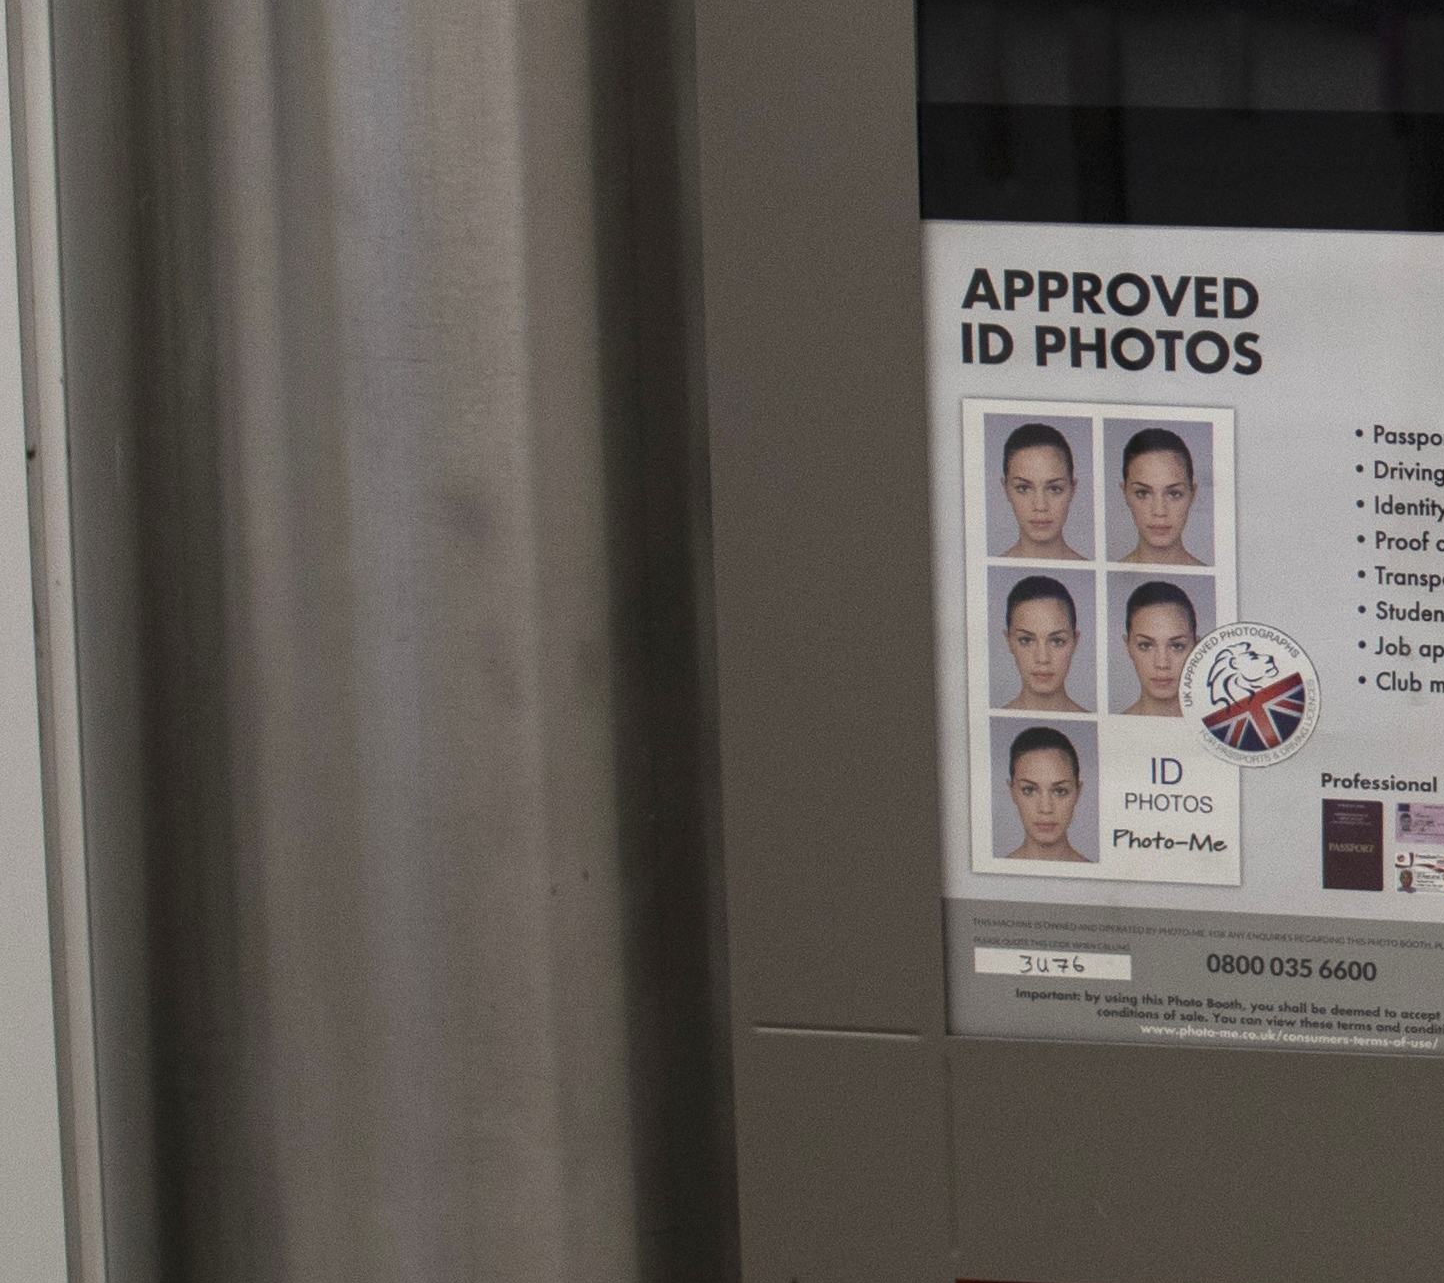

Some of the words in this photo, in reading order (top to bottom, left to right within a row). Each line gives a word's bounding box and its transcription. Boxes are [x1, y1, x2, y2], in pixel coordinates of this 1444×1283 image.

[962, 267, 1259, 321] APPROVED
[961, 322, 1013, 365] ID
[1034, 324, 1262, 376] PHOTOS
[1375, 530, 1429, 552] Proof
[1219, 626, 1300, 659] PHOTOGRAPHS
[1375, 637, 1412, 657] Job
[1184, 636, 1219, 689] APPROVED
[1375, 670, 1422, 693] Club
[1183, 691, 1192, 707] UK
[1150, 756, 1183, 785] ID
[1320, 770, 1438, 793] Professional
[1124, 791, 1213, 814] PHOTOS
[1112, 828, 1227, 853] Photo-Me
[1328, 842, 1375, 854] PASSPORT
[1205, 952, 1265, 976] 0800
[1268, 956, 1313, 978] 035
[1318, 958, 1377, 982] 6600
[1015, 987, 1081, 1004] Important:
[1084, 989, 1100, 1005] by
[1104, 991, 1138, 1007] using
[1141, 993, 1164, 1005] this
[1167, 994, 1203, 1008] Photo
[1206, 997, 1245, 1011] Booth,
[1250, 1003, 1274, 1014] you
[1278, 1000, 1307, 1013] shall
[1310, 1002, 1326, 1015] be
[1330, 1003, 1380, 1018] deemed
[1384, 1008, 1397, 1018] to
[1400, 1009, 1440, 1022] accept
